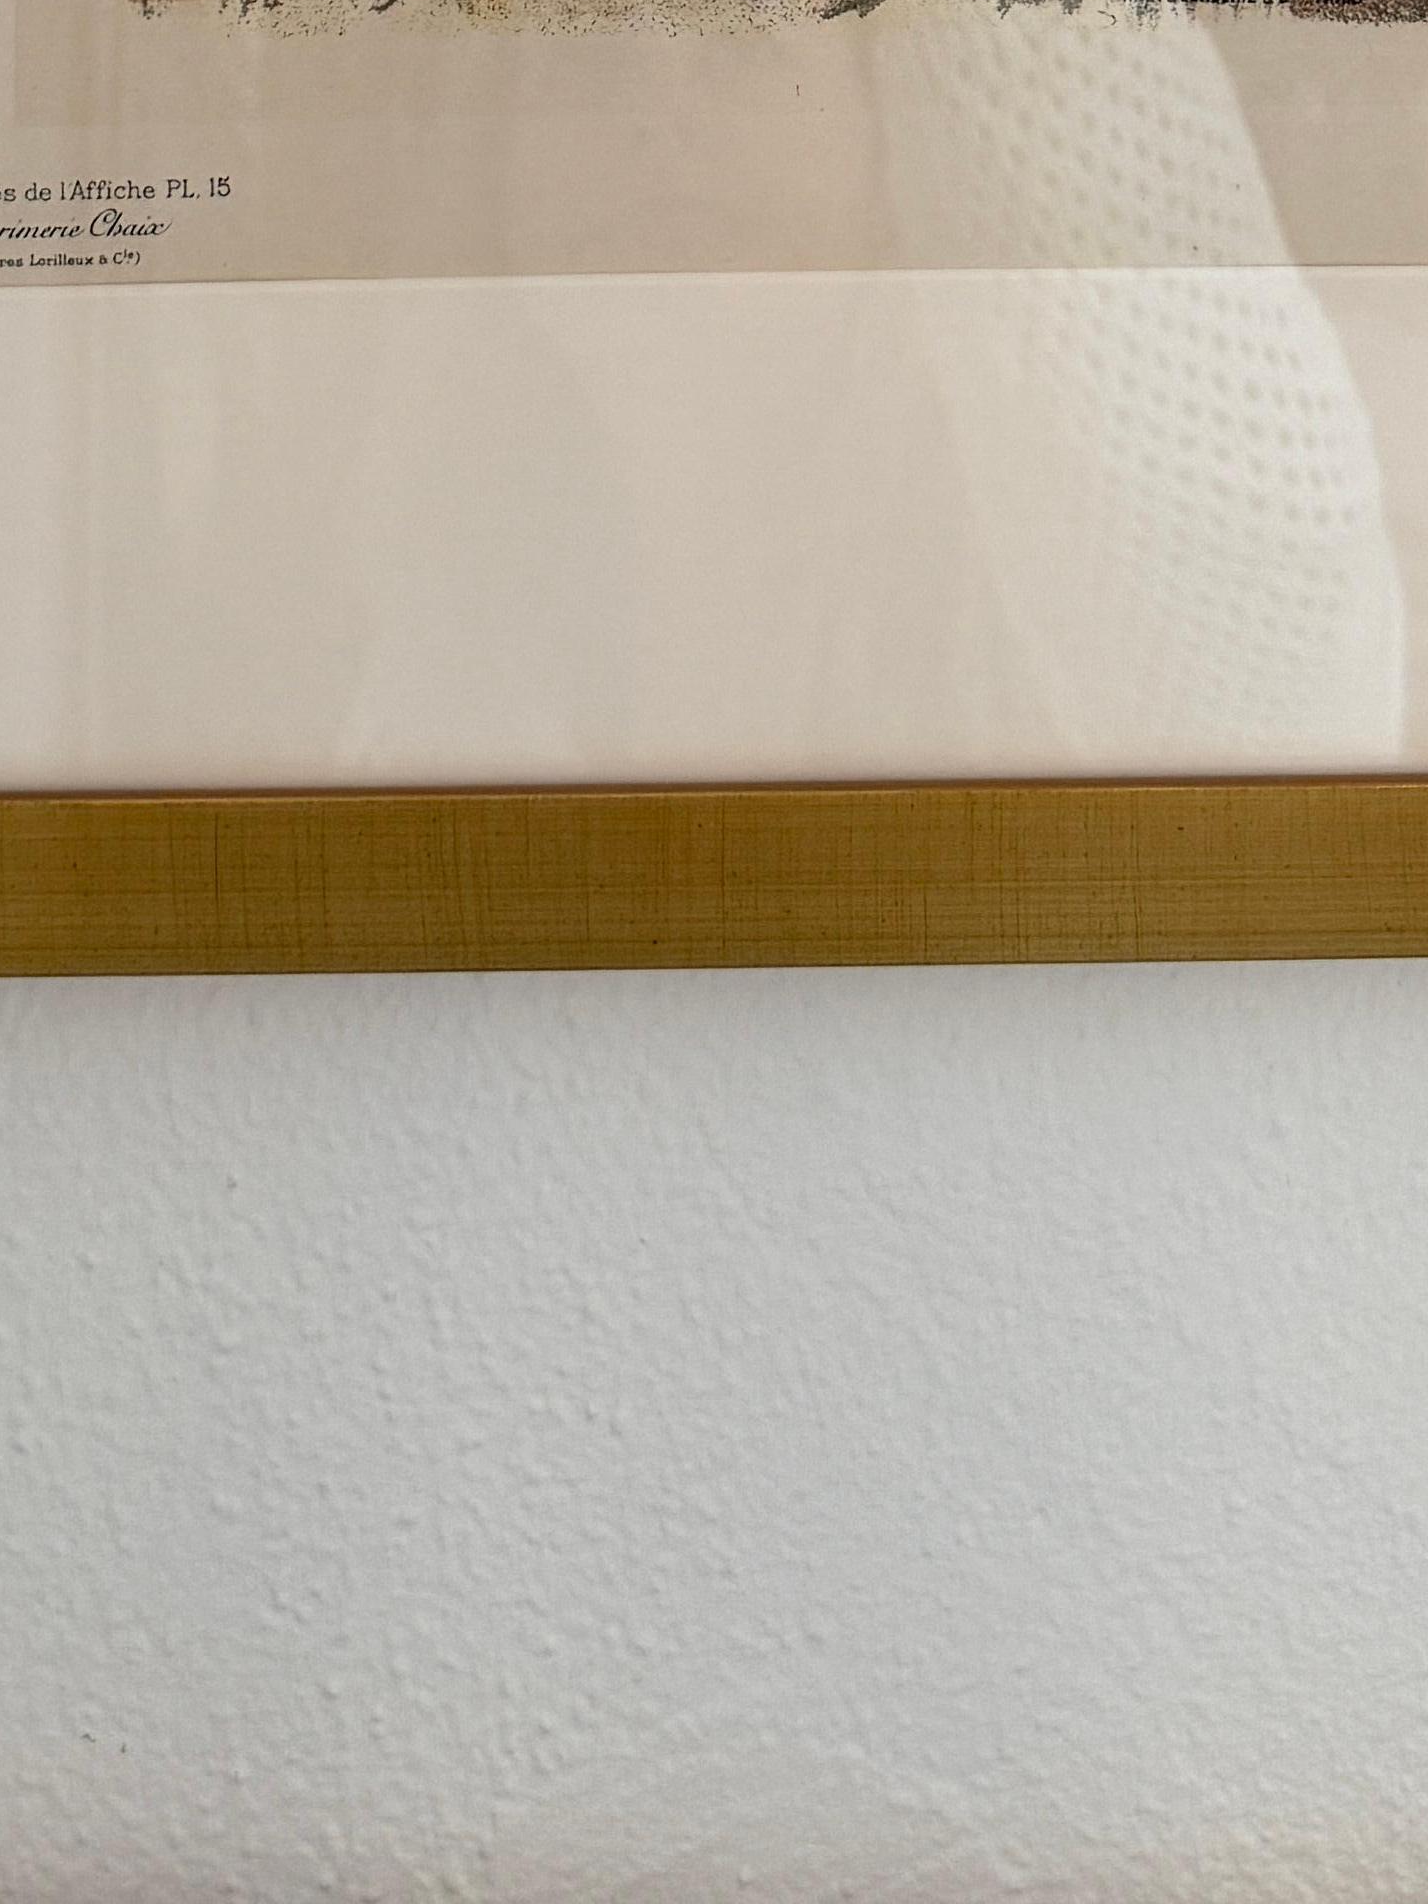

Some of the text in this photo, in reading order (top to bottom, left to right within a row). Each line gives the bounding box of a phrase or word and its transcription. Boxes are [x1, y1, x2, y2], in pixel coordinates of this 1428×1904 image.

[25, 182, 52, 202] de
[60, 178, 156, 200] l'Affiche
[166, 178, 202, 199] PL.
[209, 175, 233, 197] 15
[89, 208, 173, 237] Chaix
[29, 252, 94, 267] Lorilleux
